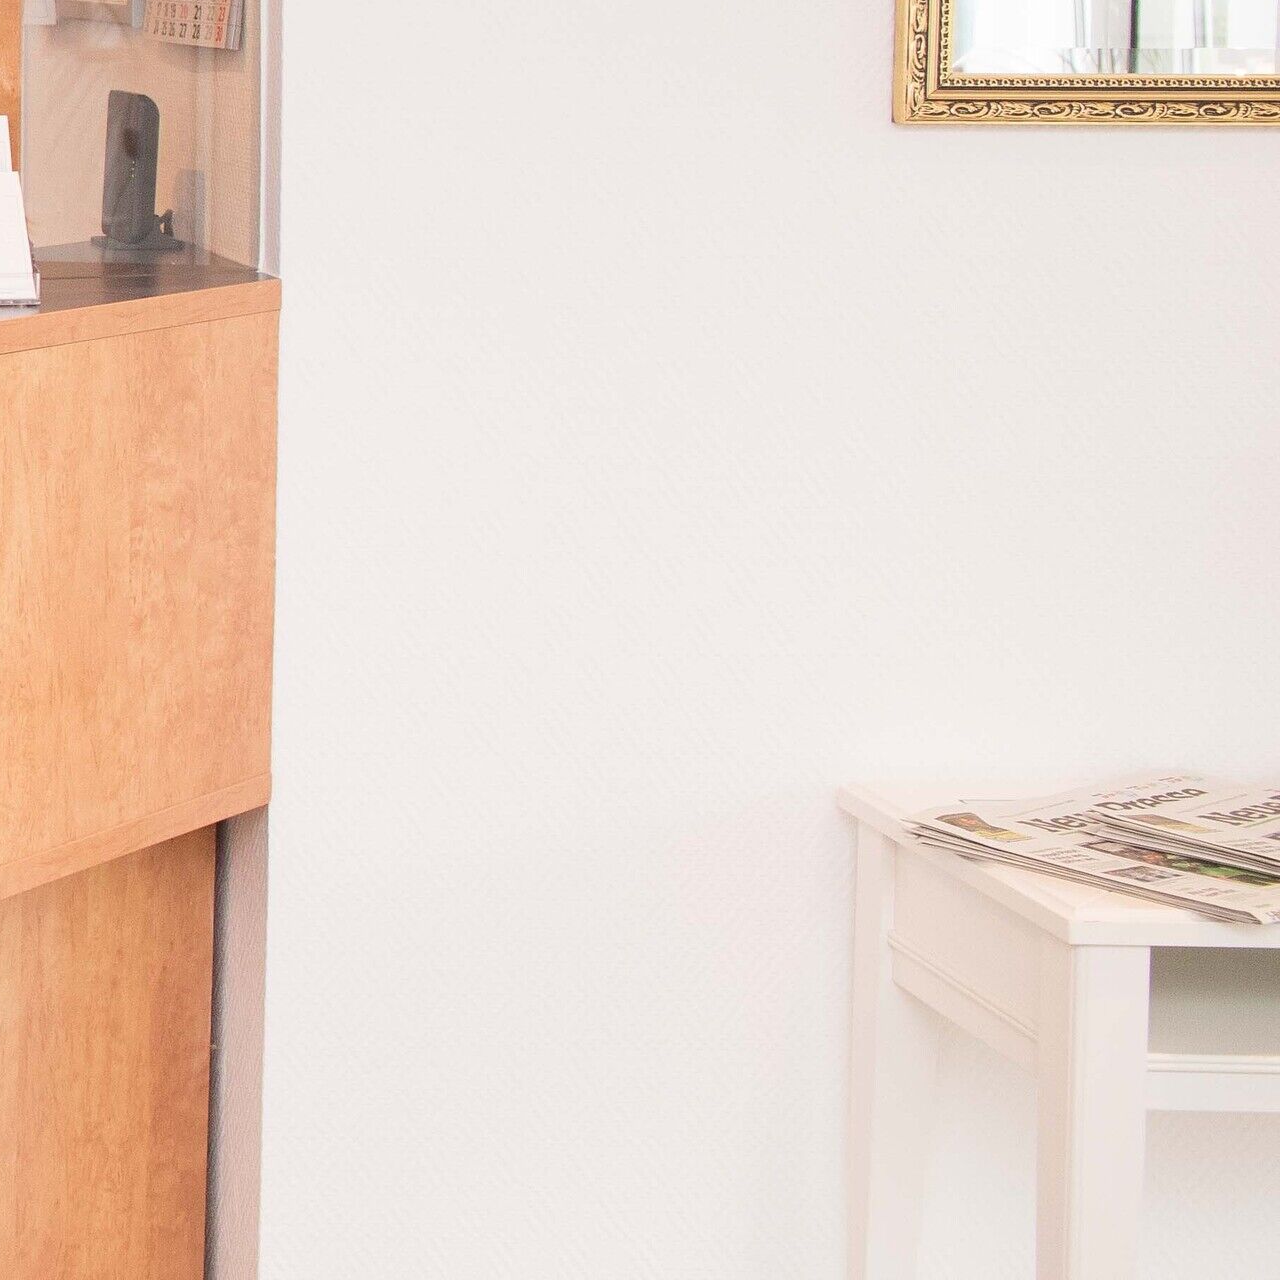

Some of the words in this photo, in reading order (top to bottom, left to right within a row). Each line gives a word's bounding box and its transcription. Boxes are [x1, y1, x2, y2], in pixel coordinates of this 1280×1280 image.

[194, 5, 202, 20] 21
[179, 23, 187, 37] 27
[192, 24, 200, 39] 28
